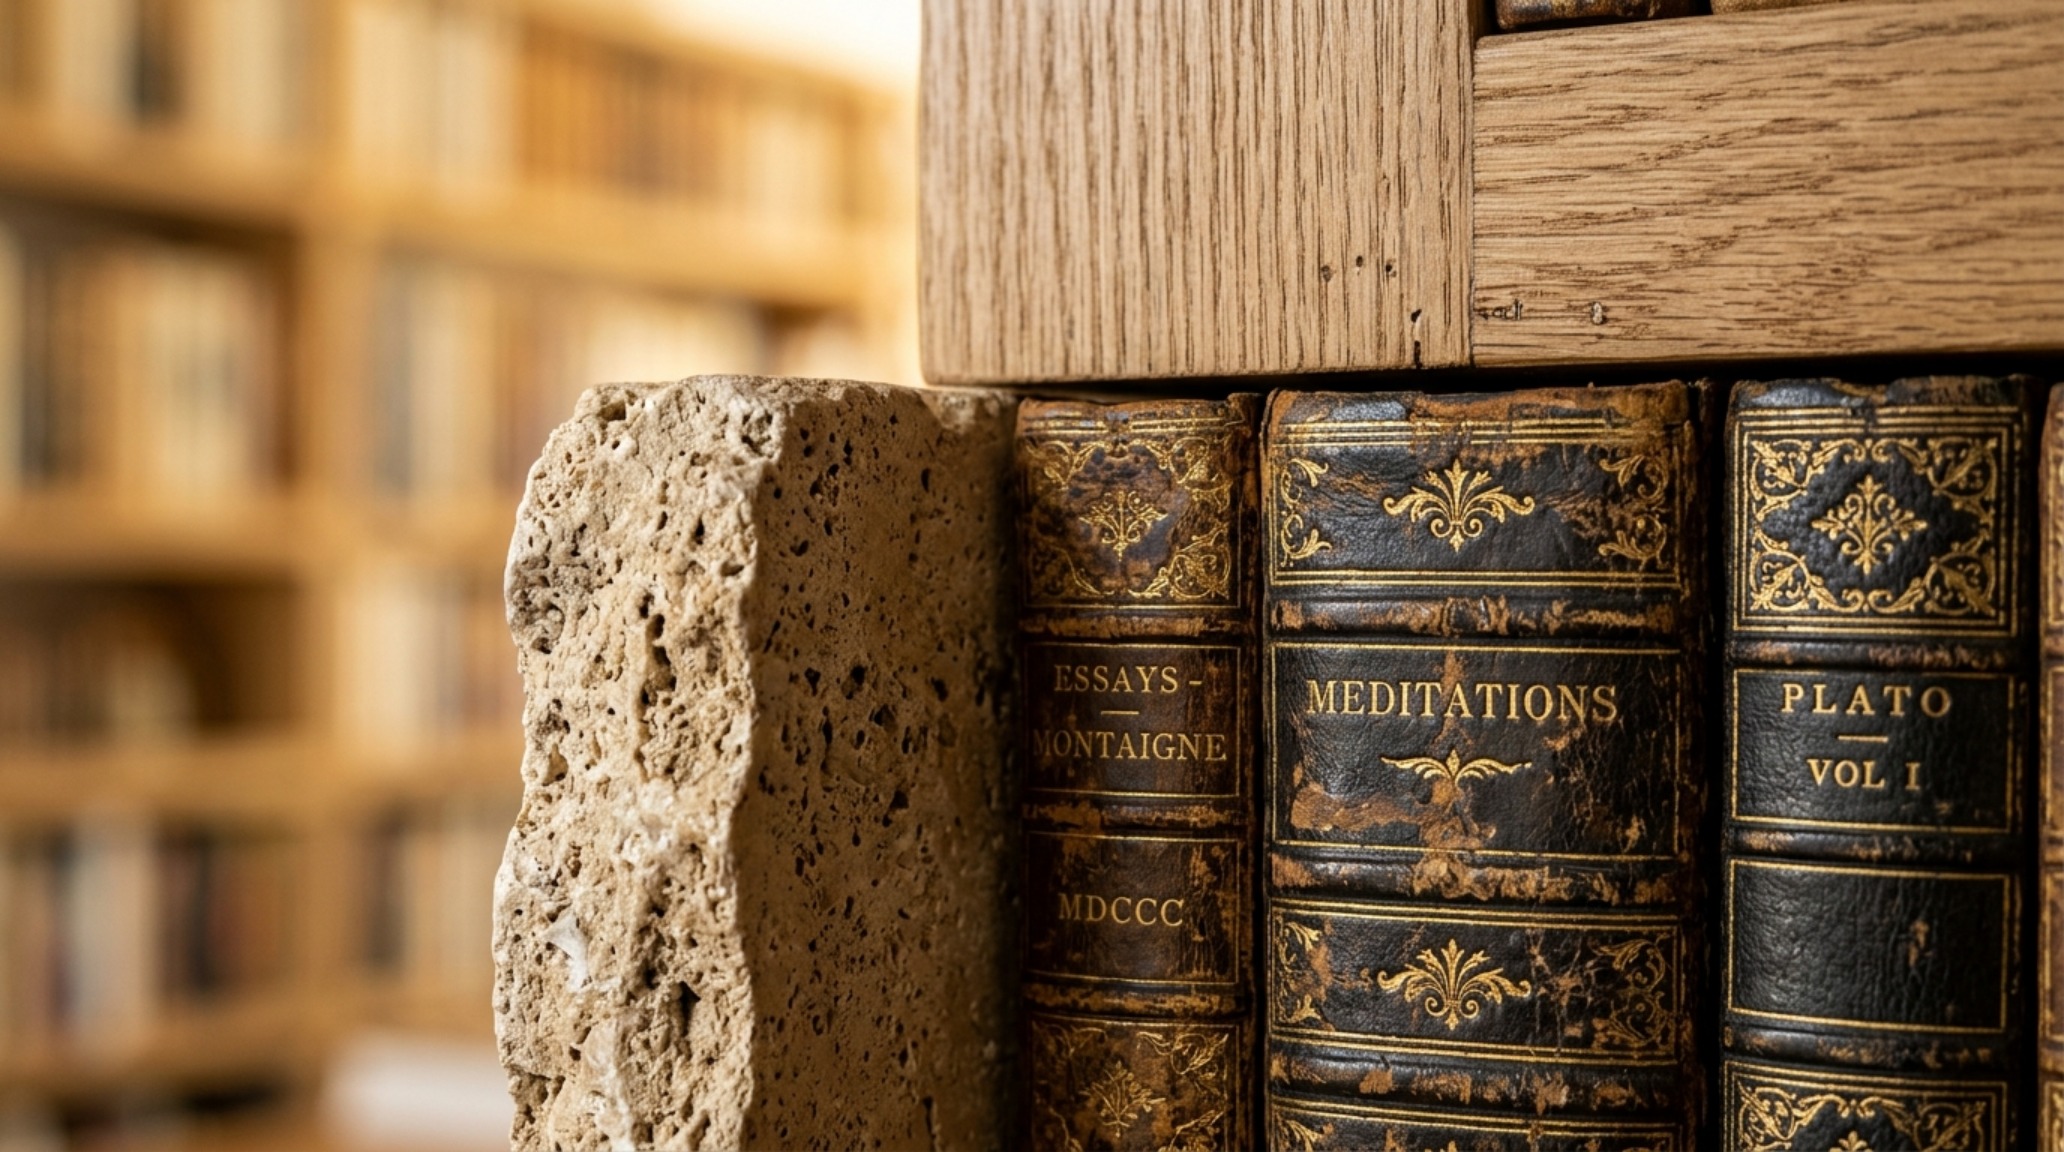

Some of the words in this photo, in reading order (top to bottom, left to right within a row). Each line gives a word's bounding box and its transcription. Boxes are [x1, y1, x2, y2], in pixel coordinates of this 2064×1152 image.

[1053, 664, 1179, 694] ESSAYS
[1306, 679, 1618, 722] MEDITATIONS
[1780, 682, 1953, 718] PLATO
[1033, 729, 1228, 761] MONTAIGNE
[1807, 758, 1886, 789] VOL
[1905, 761, 1922, 791] I
[1057, 893, 1186, 926] MDCCC
